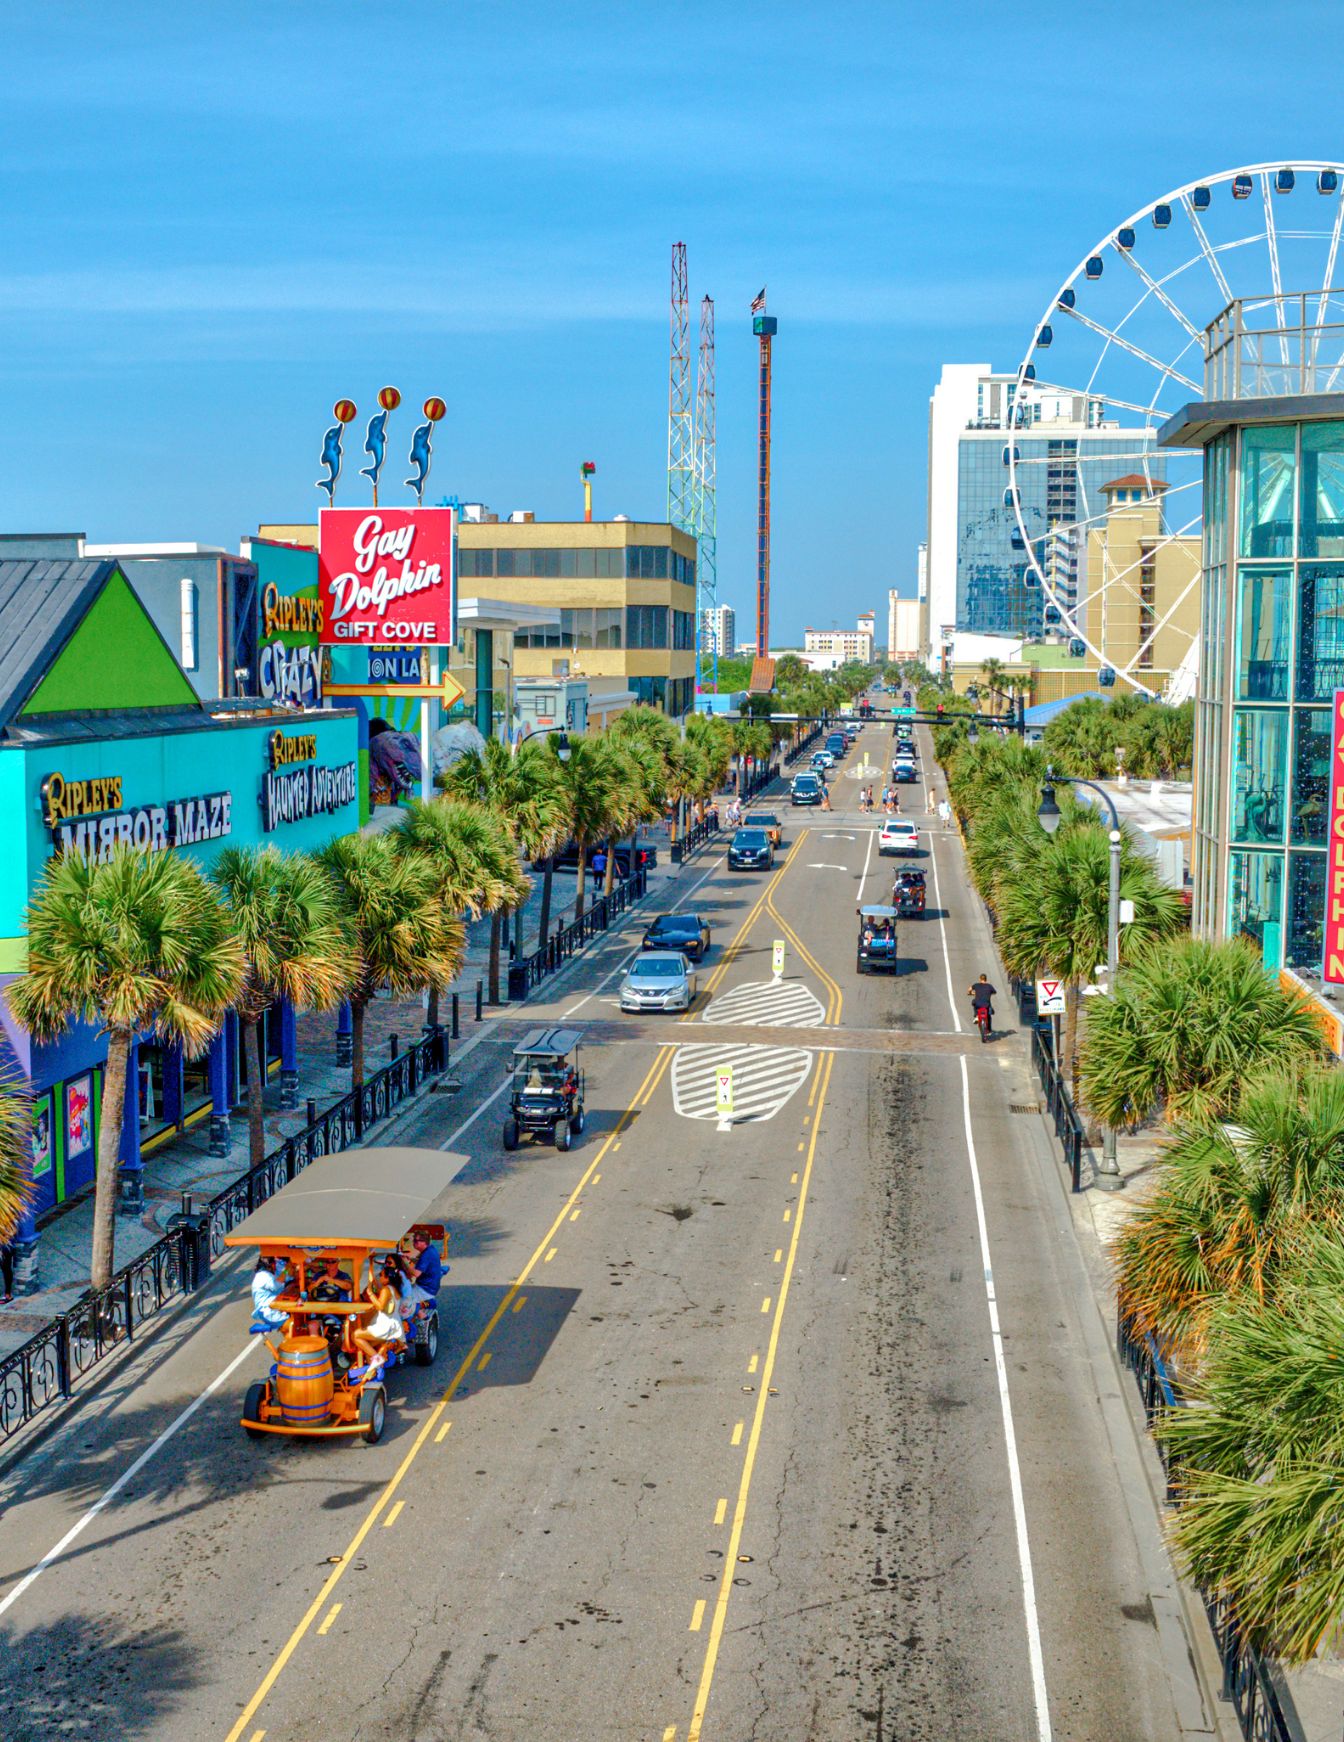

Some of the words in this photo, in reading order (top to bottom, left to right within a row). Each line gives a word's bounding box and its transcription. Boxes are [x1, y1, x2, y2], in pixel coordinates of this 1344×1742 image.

[353, 515, 415, 573] Gay
[328, 559, 441, 620] Dolphin
[333, 621, 378, 638] GIFT
[382, 621, 436, 638] COVE
[273, 729, 317, 770] RIPLEY'S
[47, 771, 123, 829] RIPLEY'S
[175, 792, 232, 847] MAZE
[267, 770, 310, 832] HAUNTED
[311, 763, 356, 817] ADVENTURE
